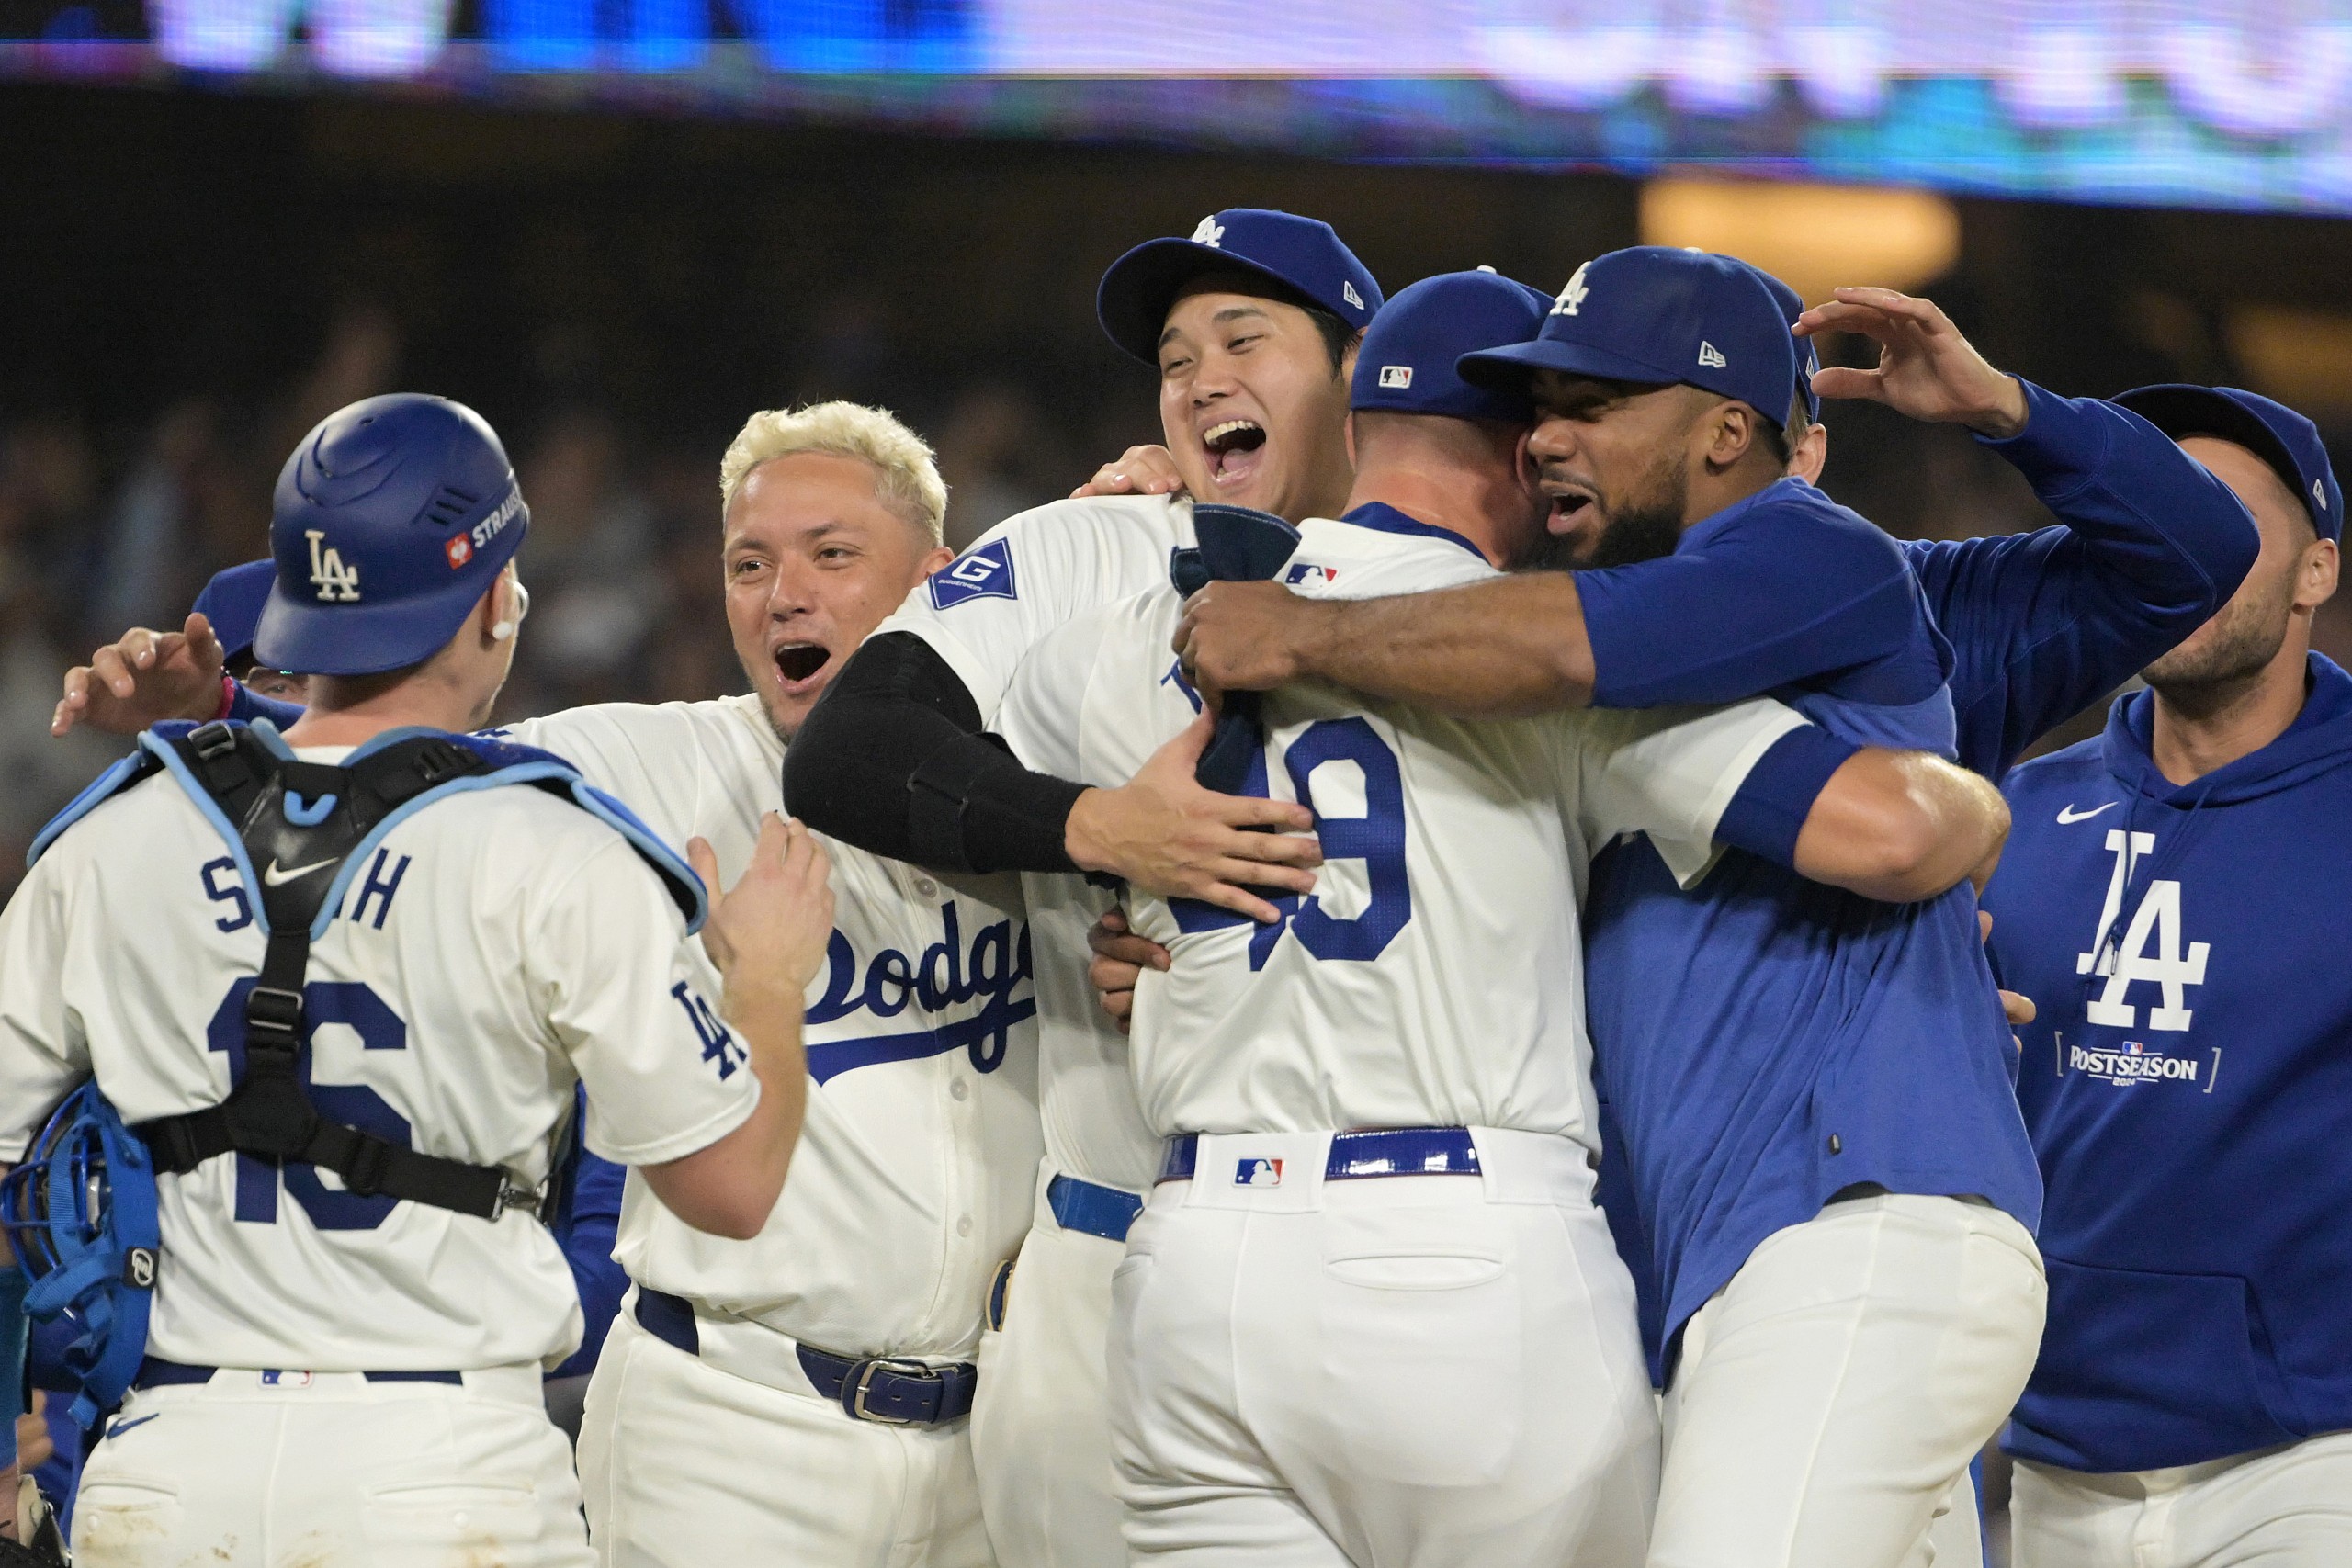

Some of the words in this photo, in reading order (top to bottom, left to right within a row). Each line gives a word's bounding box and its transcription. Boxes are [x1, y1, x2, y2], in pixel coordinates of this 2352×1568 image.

[304, 529, 360, 600] LA
[2076, 829, 2211, 1032] LA
[671, 980, 747, 1081] LA
[2069, 1045, 2198, 1081] POSTSEASON
[207, 976, 413, 1231] 16
